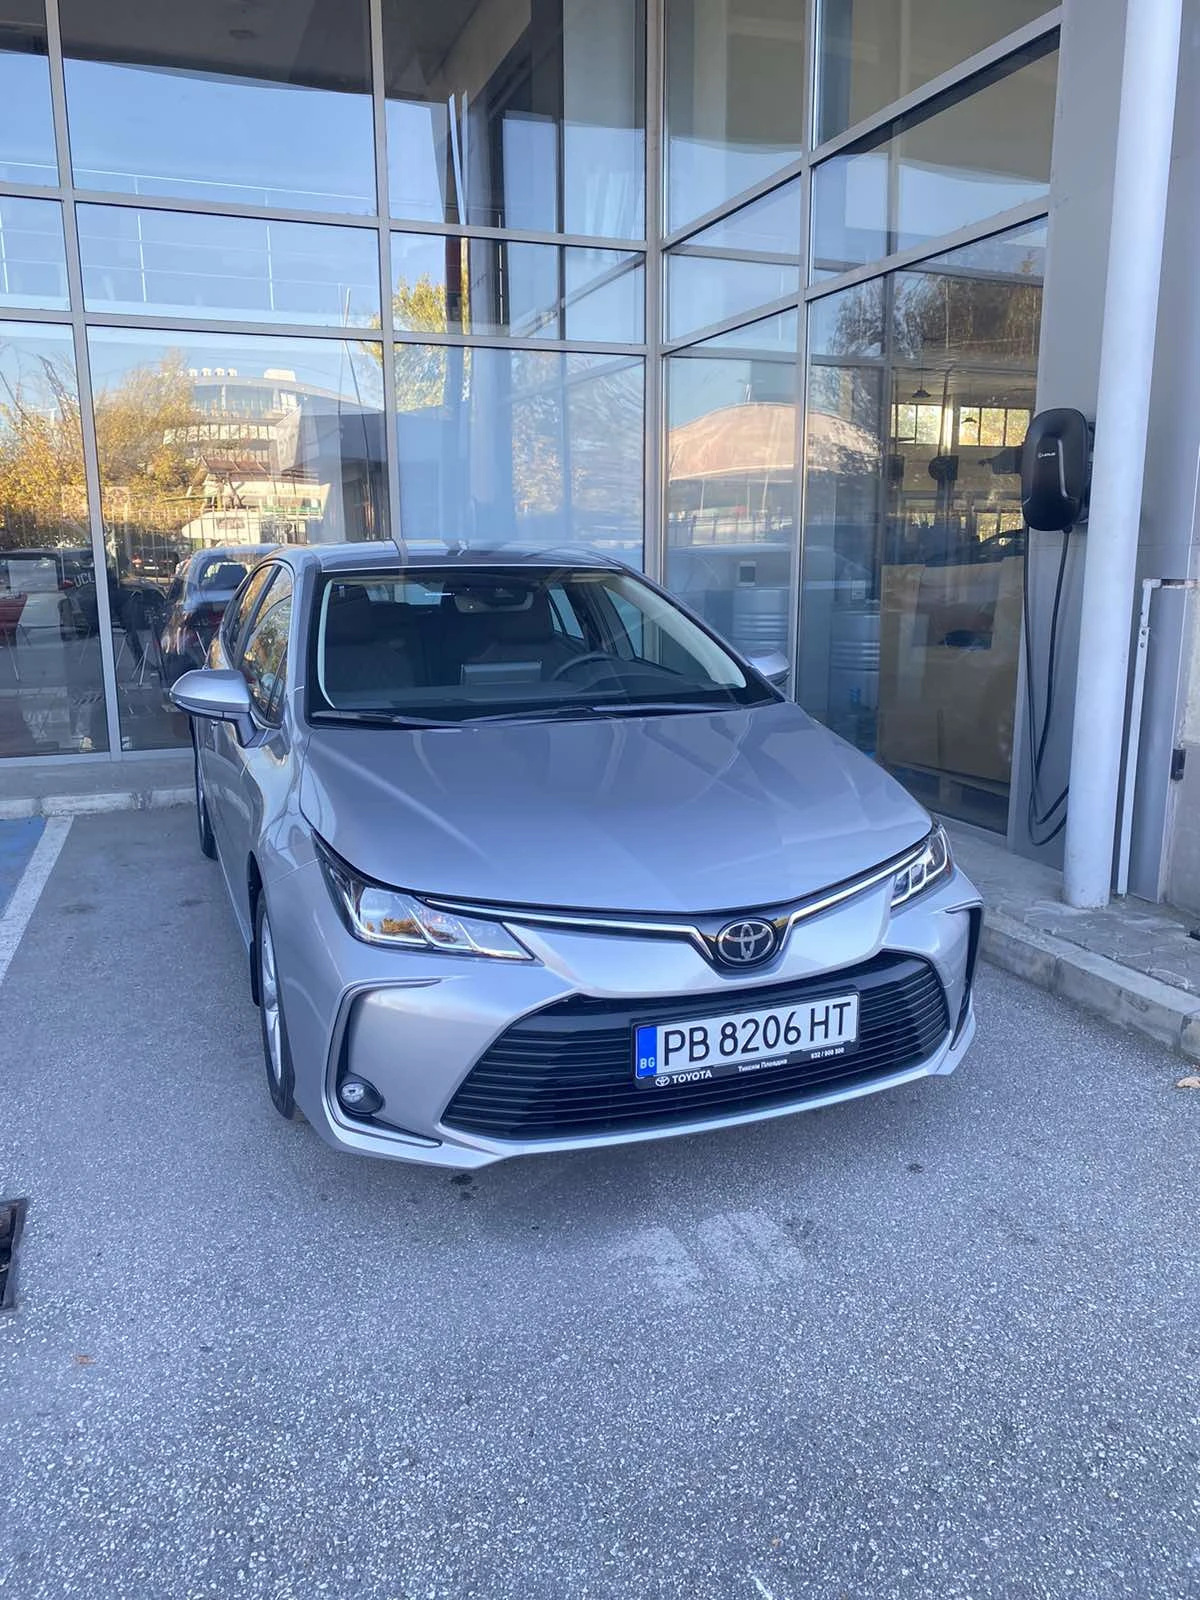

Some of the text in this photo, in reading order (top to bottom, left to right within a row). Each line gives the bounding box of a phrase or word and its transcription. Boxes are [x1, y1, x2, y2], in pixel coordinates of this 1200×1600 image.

[664, 1002, 852, 1066] PB 8206 HT
[640, 1057, 655, 1069] BG
[672, 1070, 712, 1084] TOYOTA
